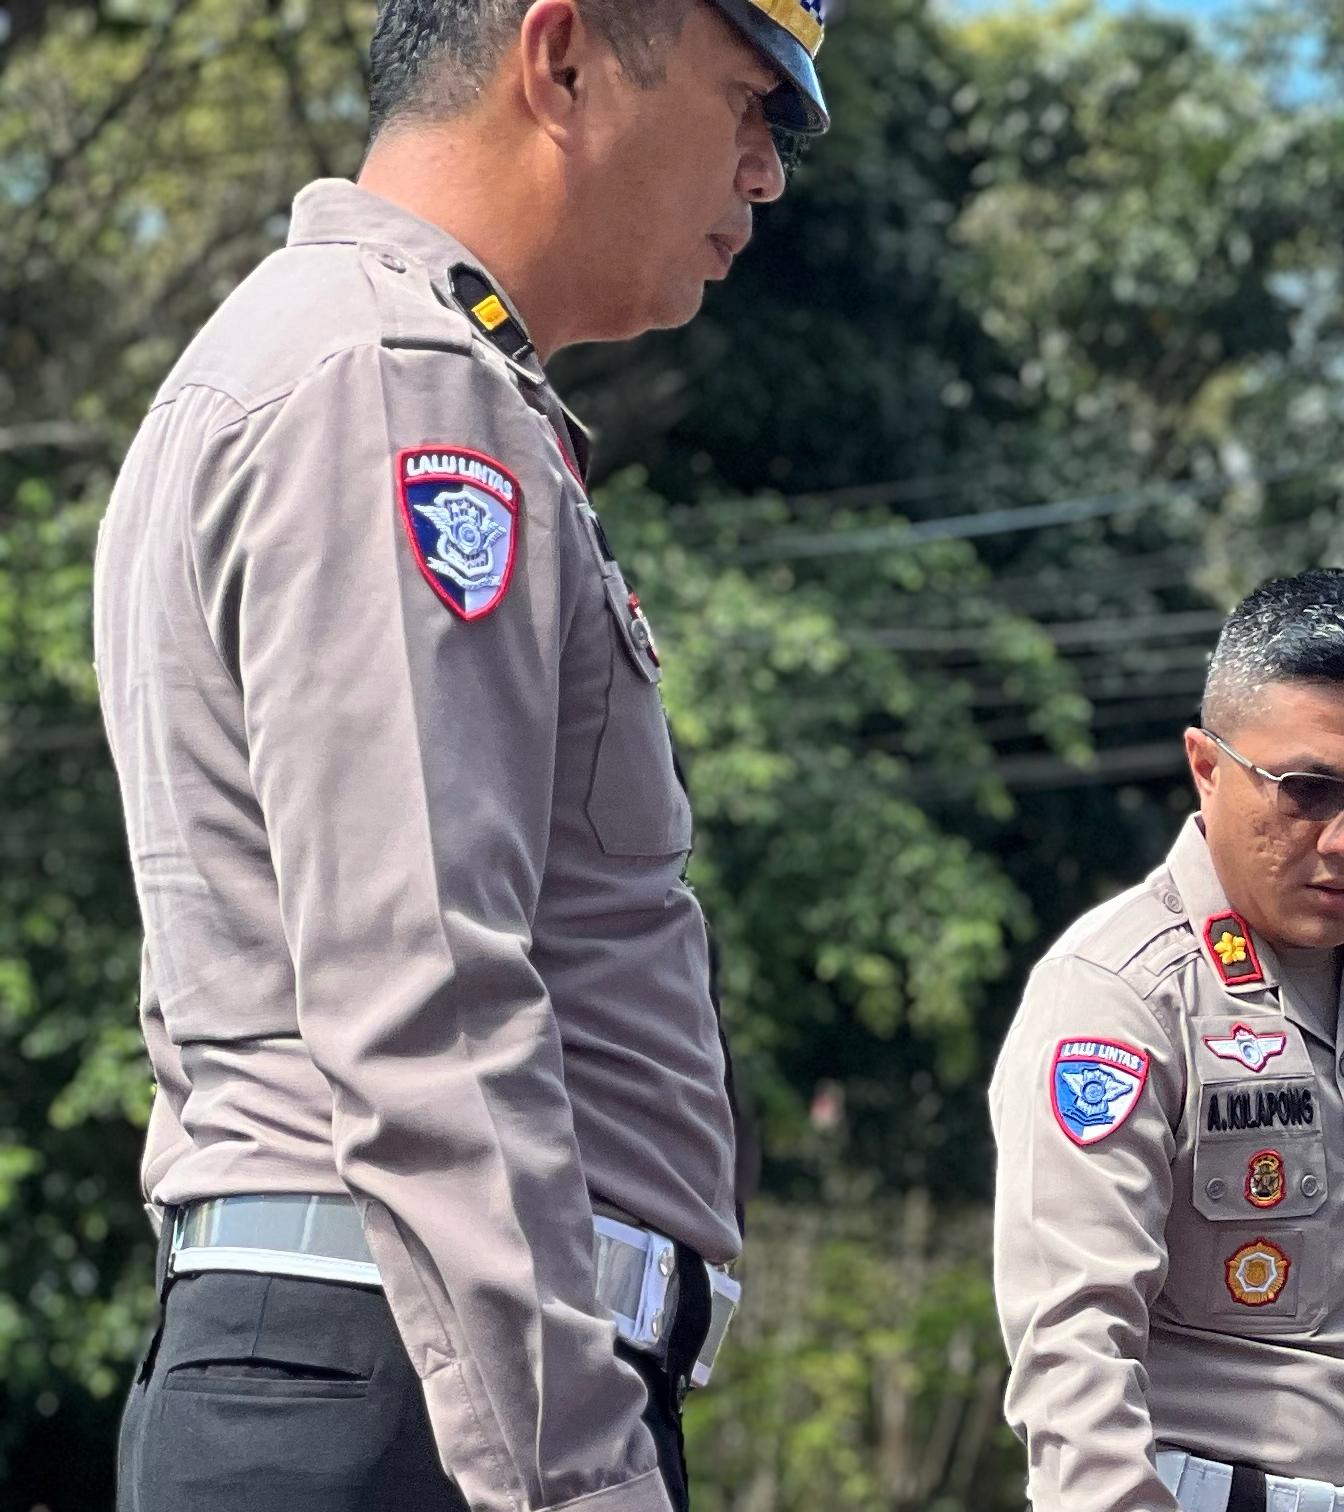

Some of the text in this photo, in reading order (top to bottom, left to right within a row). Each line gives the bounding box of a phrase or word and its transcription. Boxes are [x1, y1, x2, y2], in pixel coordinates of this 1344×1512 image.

[407, 454, 513, 501] LALU LINTAS
[1064, 1042, 1141, 1070] LALU LINTAS
